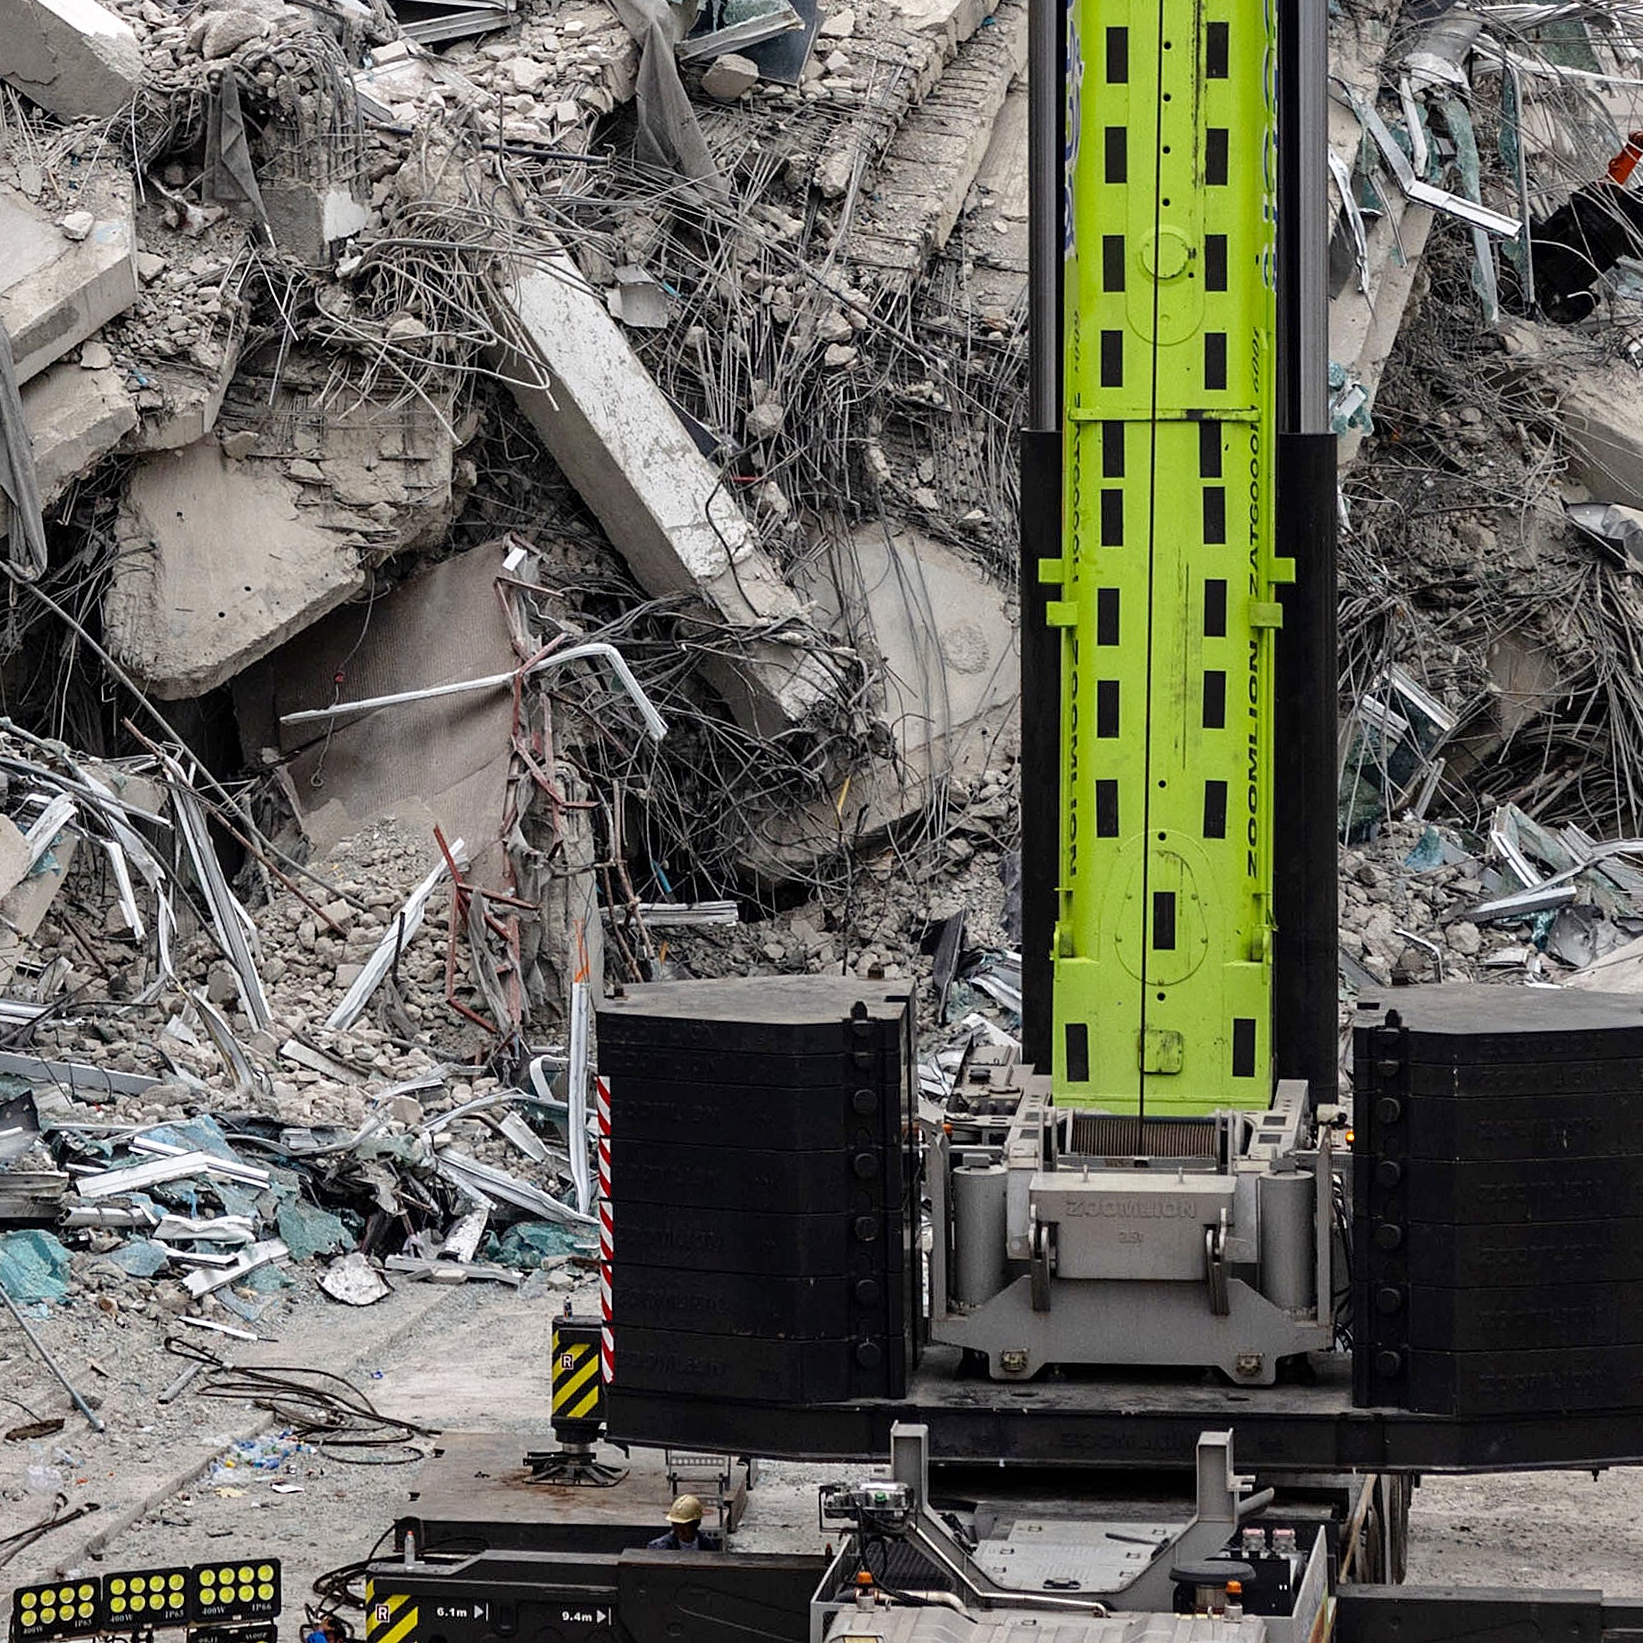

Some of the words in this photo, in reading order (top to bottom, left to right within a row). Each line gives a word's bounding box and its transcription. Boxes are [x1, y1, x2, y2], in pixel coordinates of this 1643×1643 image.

[1069, 639, 1079, 877] ZOOMLION
[1248, 639, 1259, 879] ZOOMLION
[563, 1355, 572, 1368] R
[377, 1607, 388, 1621] R
[436, 1607, 468, 1618] 6.1m
[561, 1610, 593, 1622] 9.4m
